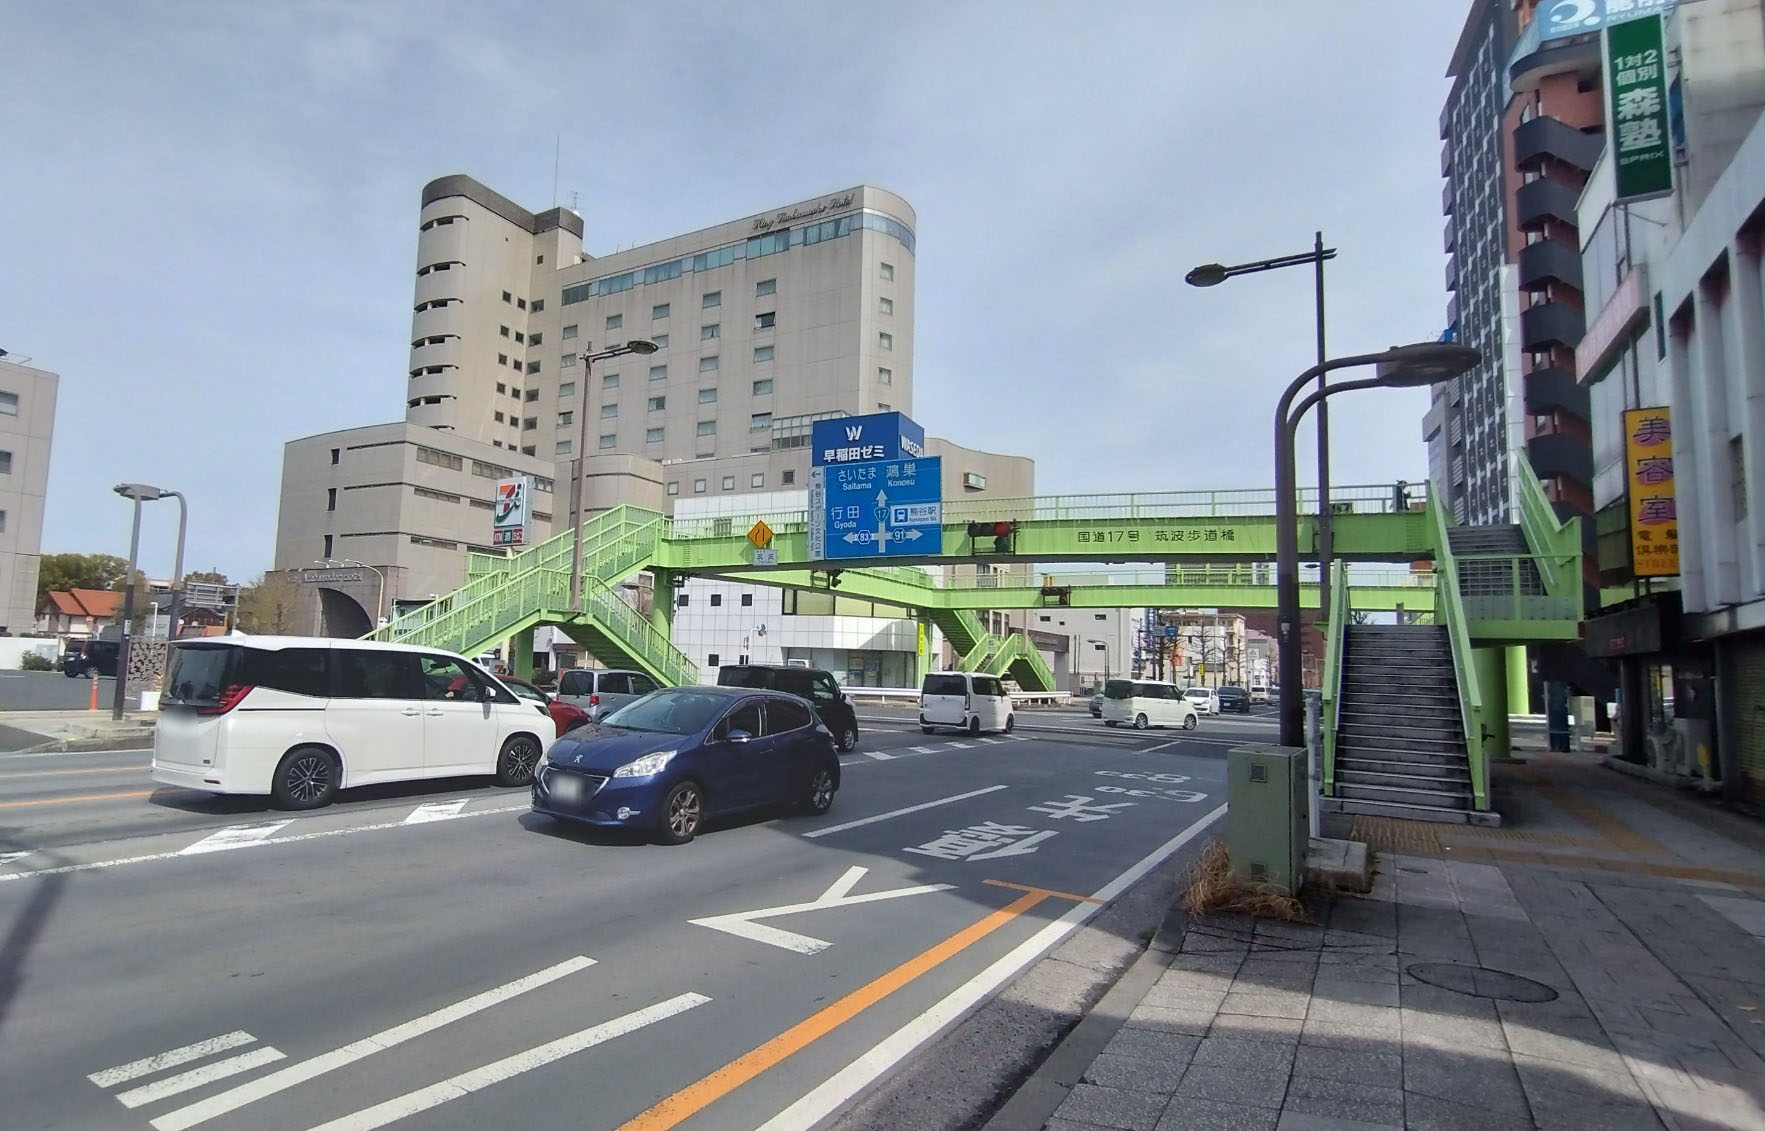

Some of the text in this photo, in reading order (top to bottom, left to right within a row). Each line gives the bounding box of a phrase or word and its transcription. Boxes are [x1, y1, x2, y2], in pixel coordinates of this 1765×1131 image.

[1613, 49, 1658, 70] 1対2
[1616, 66, 1657, 87] 個別
[1617, 86, 1662, 151] 森塾
[823, 445, 885, 463] 早稲田ゼミ
[838, 466, 877, 482] さいたま
[1633, 415, 1677, 523] 美容室
[842, 479, 916, 491] Saitama Konosu
[831, 506, 860, 520] 行田
[877, 508, 887, 518] 17
[909, 506, 937, 516] 熊谷駅
[834, 521, 857, 530] Gyoda
[859, 532, 869, 541] 83
[895, 530, 904, 540] 91
[1077, 529, 1235, 542] 国道17号 筑波歩道橋
